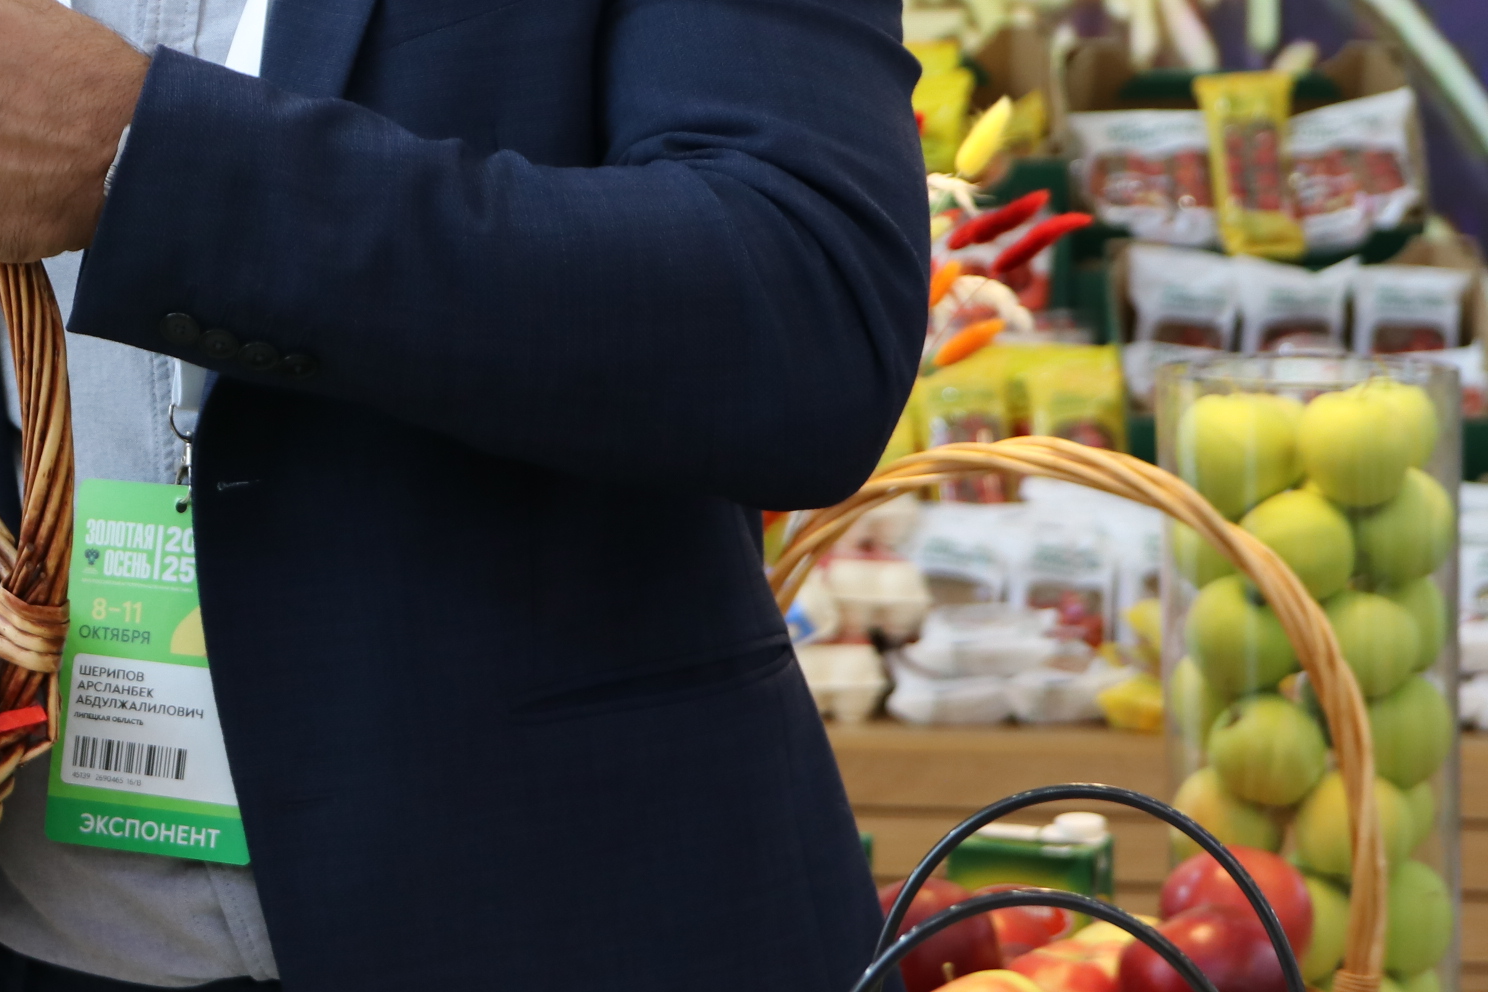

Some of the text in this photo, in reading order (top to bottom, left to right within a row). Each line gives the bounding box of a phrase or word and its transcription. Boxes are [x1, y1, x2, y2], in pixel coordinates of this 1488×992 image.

[85, 518, 155, 550] ЗОЛОТАЯ
[164, 525, 195, 554] 20
[103, 549, 152, 579] ОСЕНЬ
[161, 555, 196, 584] 25
[78, 624, 151, 645] ОКТЯБРЯ
[79, 664, 145, 683] ШЕРИПОВ
[77, 679, 154, 699] АРСЛАНБЕК
[73, 711, 144, 726] ЛИПЕЦКАЯ ОБЛАСТЬ
[75, 693, 204, 719] АБДУЛЖАЛИЛОВИЧ
[79, 812, 221, 849] ЭКСПОНЕНТ
